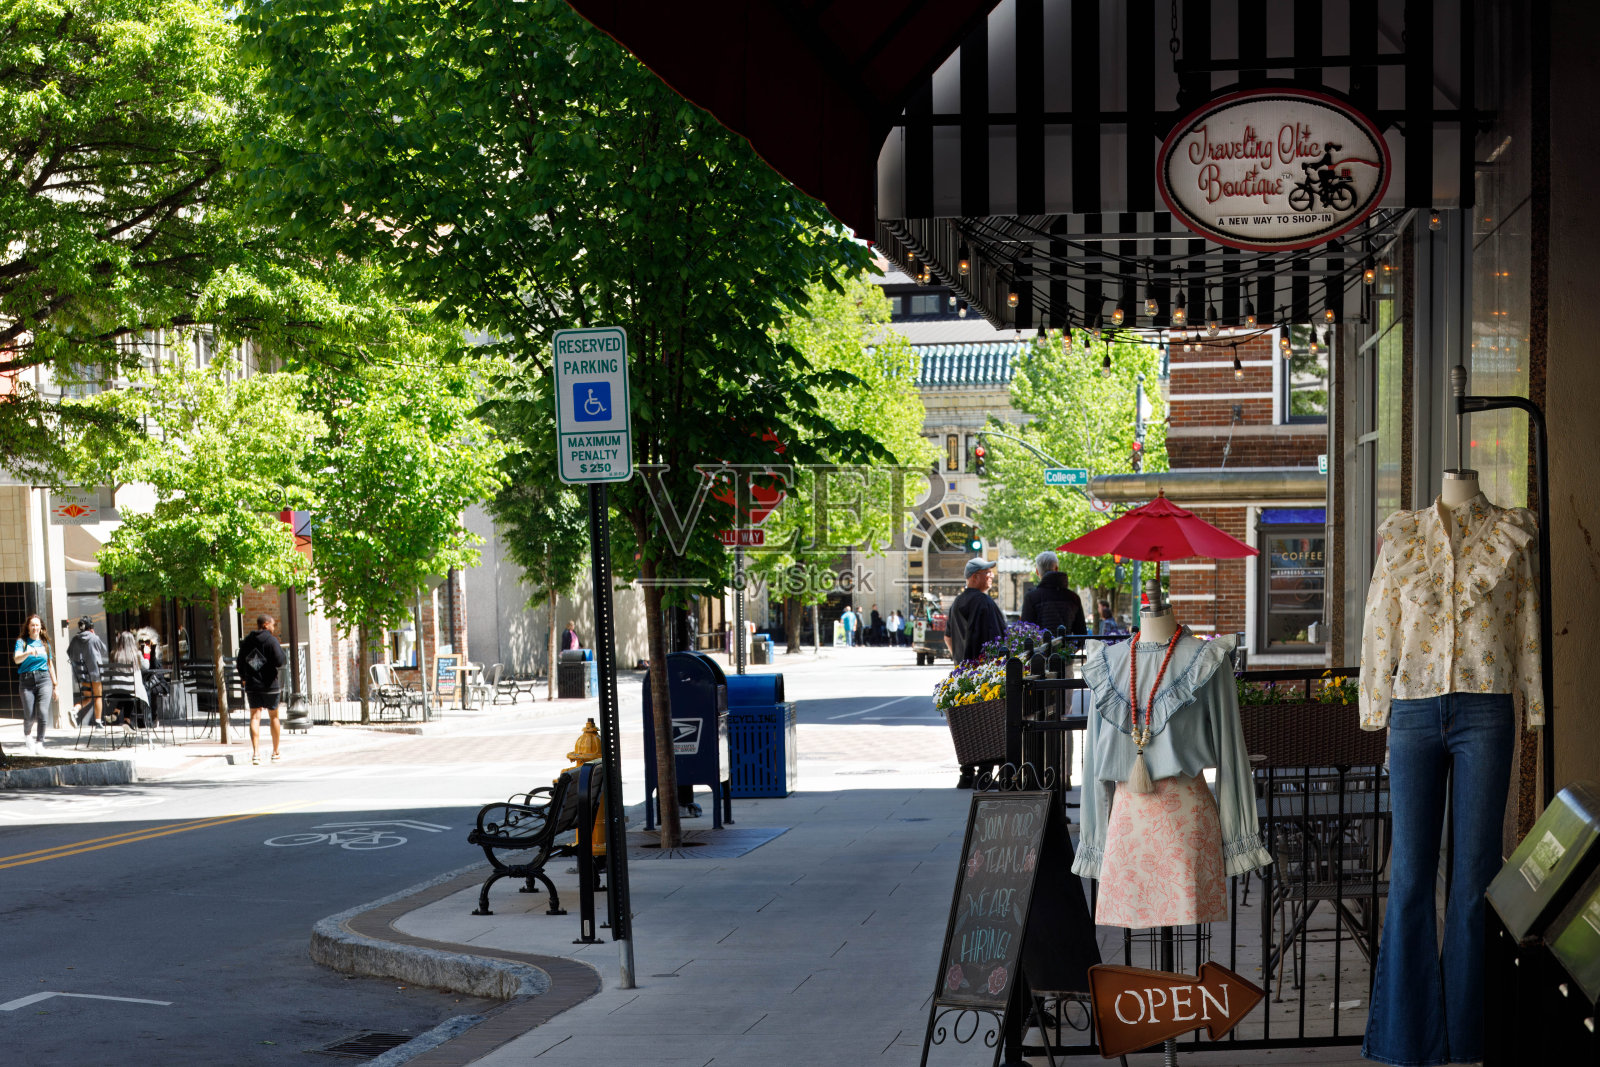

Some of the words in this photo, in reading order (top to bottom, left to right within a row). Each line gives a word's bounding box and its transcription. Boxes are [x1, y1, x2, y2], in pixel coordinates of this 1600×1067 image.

[1188, 124, 1273, 170] Traveling
[1277, 121, 1322, 164] Chic
[1197, 163, 1284, 205] Boutique
[1218, 217, 1225, 226] A
[1228, 217, 1249, 225] NEW
[1252, 216, 1273, 225] WAY
[1277, 215, 1289, 224] TO
[1292, 214, 1332, 224] SHOP-IN
[558, 337, 621, 354] RESERVED
[563, 358, 618, 375] PARKING
[568, 435, 621, 448] MAXIMUM
[571, 449, 618, 461] PENALTY
[1046, 471, 1077, 485] College
[719, 532, 736, 543] LL
[741, 532, 760, 543] WAY
[1281, 551, 1323, 561] COFFEE
[727, 714, 777, 724] ECYCLING
[980, 814, 1008, 842] JOIN
[1011, 812, 1034, 839] OUR
[966, 887, 990, 917] WE
[988, 888, 1017, 918] ARE
[961, 926, 1012, 964] HIRING!
[1114, 983, 1230, 1025] OPEN
